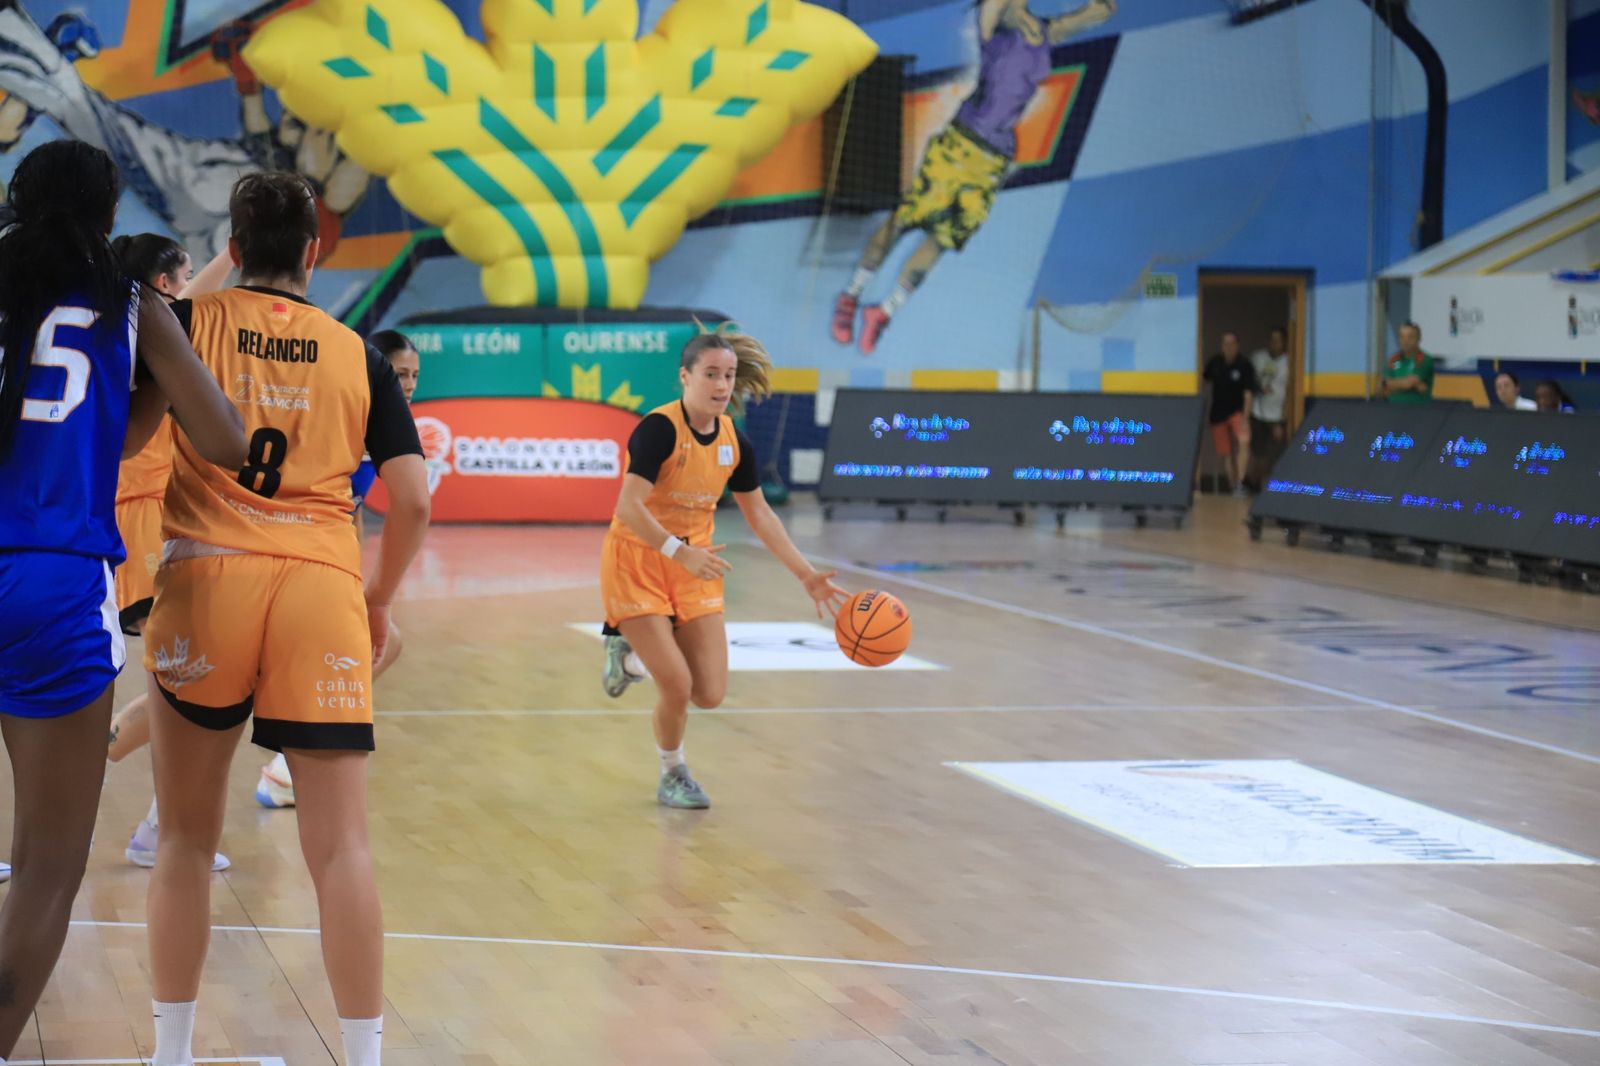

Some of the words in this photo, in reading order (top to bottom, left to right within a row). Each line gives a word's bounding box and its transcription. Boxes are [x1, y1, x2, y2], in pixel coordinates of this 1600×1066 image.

[237, 327, 319, 364] RELANCIO
[463, 329, 521, 354] LEÓN
[563, 330, 669, 353] OURENSE
[21, 305, 101, 423] 5
[256, 394, 311, 412] ZAMORA
[459, 441, 614, 456] BALONCESTO
[237, 426, 288, 500] 8
[459, 456, 545, 471] CASTILLA
[551, 459, 563, 470] Y
[567, 458, 615, 472] LEÓN
[316, 677, 364, 693] cañus
[317, 696, 365, 709] verus
